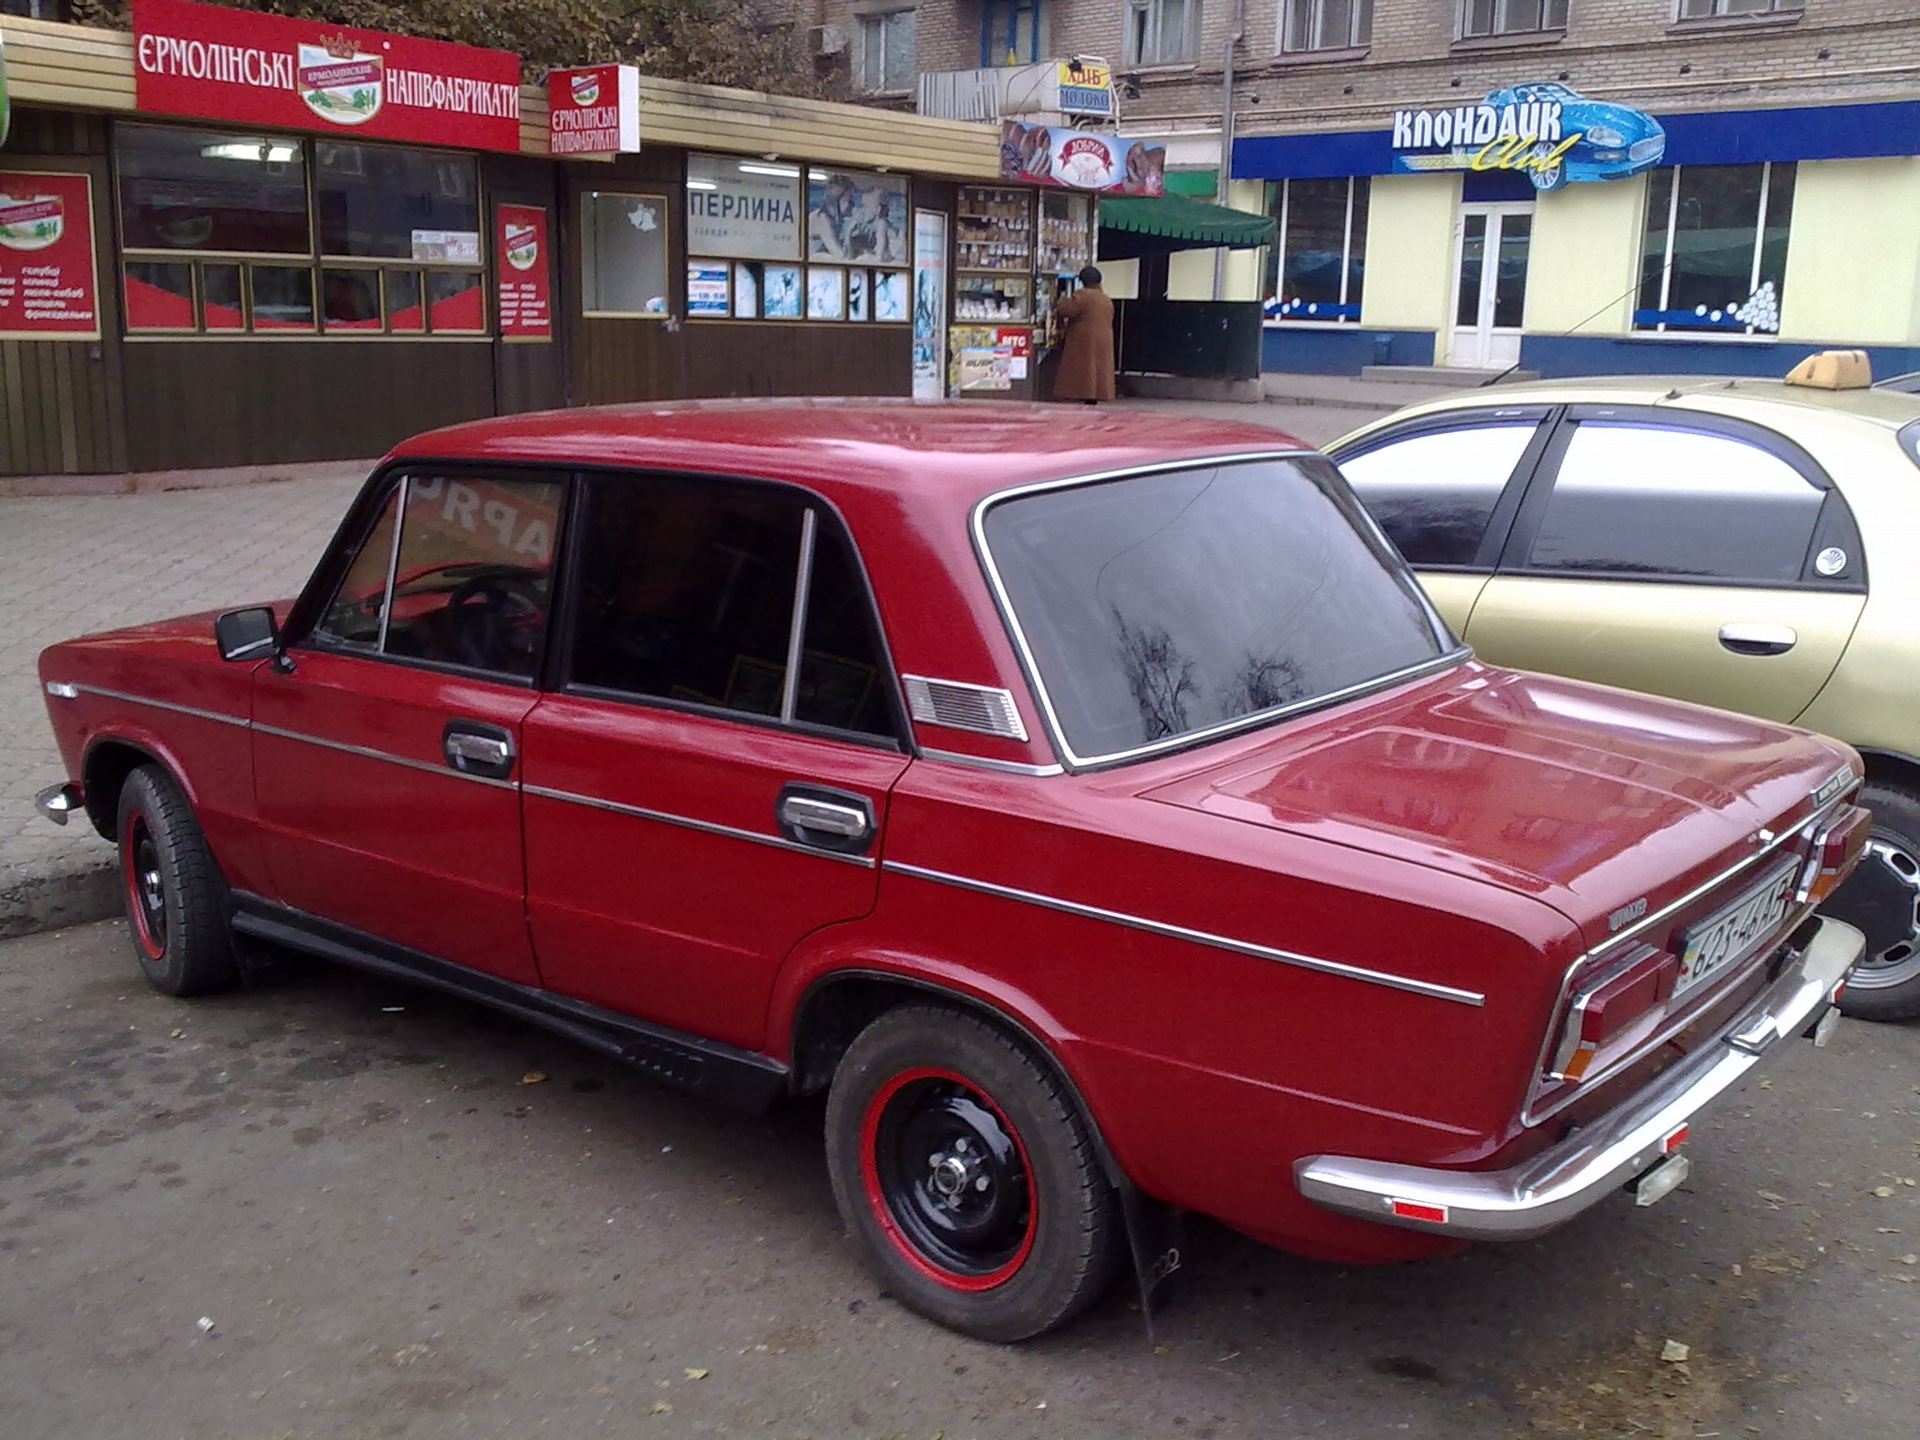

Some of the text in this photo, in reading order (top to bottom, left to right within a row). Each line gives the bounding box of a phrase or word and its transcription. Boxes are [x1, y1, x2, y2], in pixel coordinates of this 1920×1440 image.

[138, 33, 520, 119] ЄРМОЛІНСЬКІ НАПІВФАБРИКАТИ
[551, 106, 617, 132] ЄРМОЛІНСЬКІ
[1392, 94, 1563, 149] КЛОНДАЙК
[1470, 132, 1583, 172] Club
[690, 191, 795, 224] ПЕРЛИНА
[1002, 335, 1027, 348] МТС
